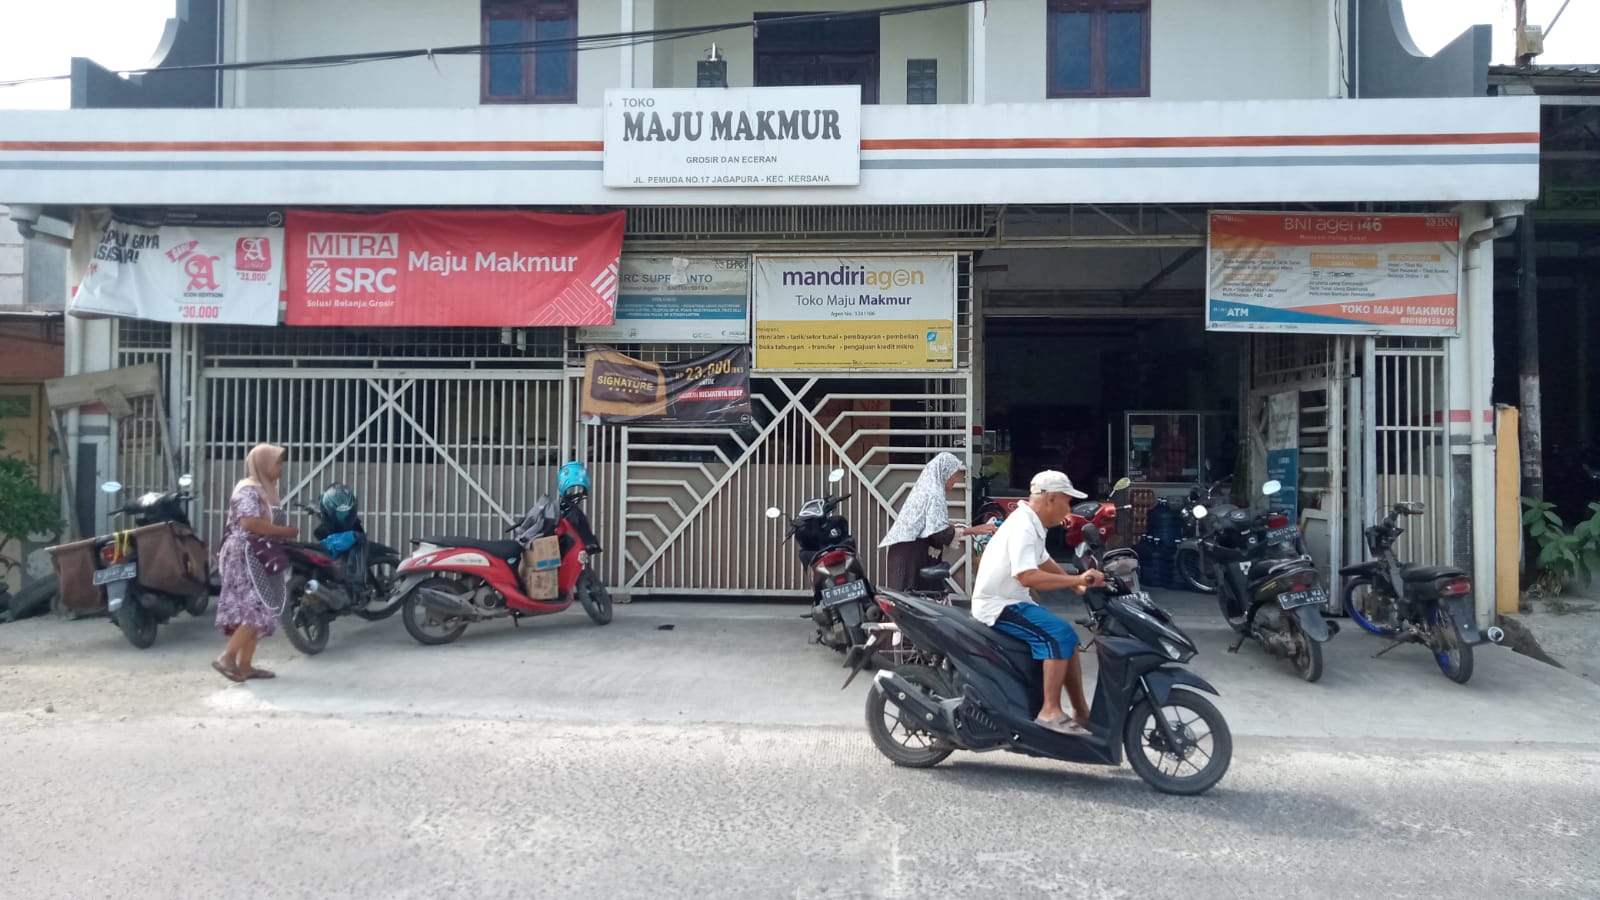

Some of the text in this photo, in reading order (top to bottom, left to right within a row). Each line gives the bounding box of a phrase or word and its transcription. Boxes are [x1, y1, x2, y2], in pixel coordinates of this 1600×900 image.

[622, 98, 655, 108] TOKO
[623, 109, 842, 142] MAJU MAKMUR
[686, 155, 777, 164] GROSIR DAN ECERAN
[648, 176, 683, 184] PEMUDA
[685, 176, 710, 184] NO.17
[1284, 217, 1312, 231] BNI
[308, 234, 396, 257] MITRA
[408, 250, 578, 276] Maju Makmur
[335, 266, 397, 293] SRC
[334, 299, 367, 308] Belanja
[368, 299, 395, 308] Grosir
[796, 295, 912, 308] Toko Maju Makmur
[1227, 307, 1249, 317] ATM
[1340, 304, 1455, 316] TOKO MAJU MAKMUR
[823, 332, 839, 340] tunai
[843, 332, 881, 341] pembayaran
[886, 332, 919, 340] pembelian
[775, 344, 805, 352] tabungan
[597, 375, 655, 391] SIGNATURE
